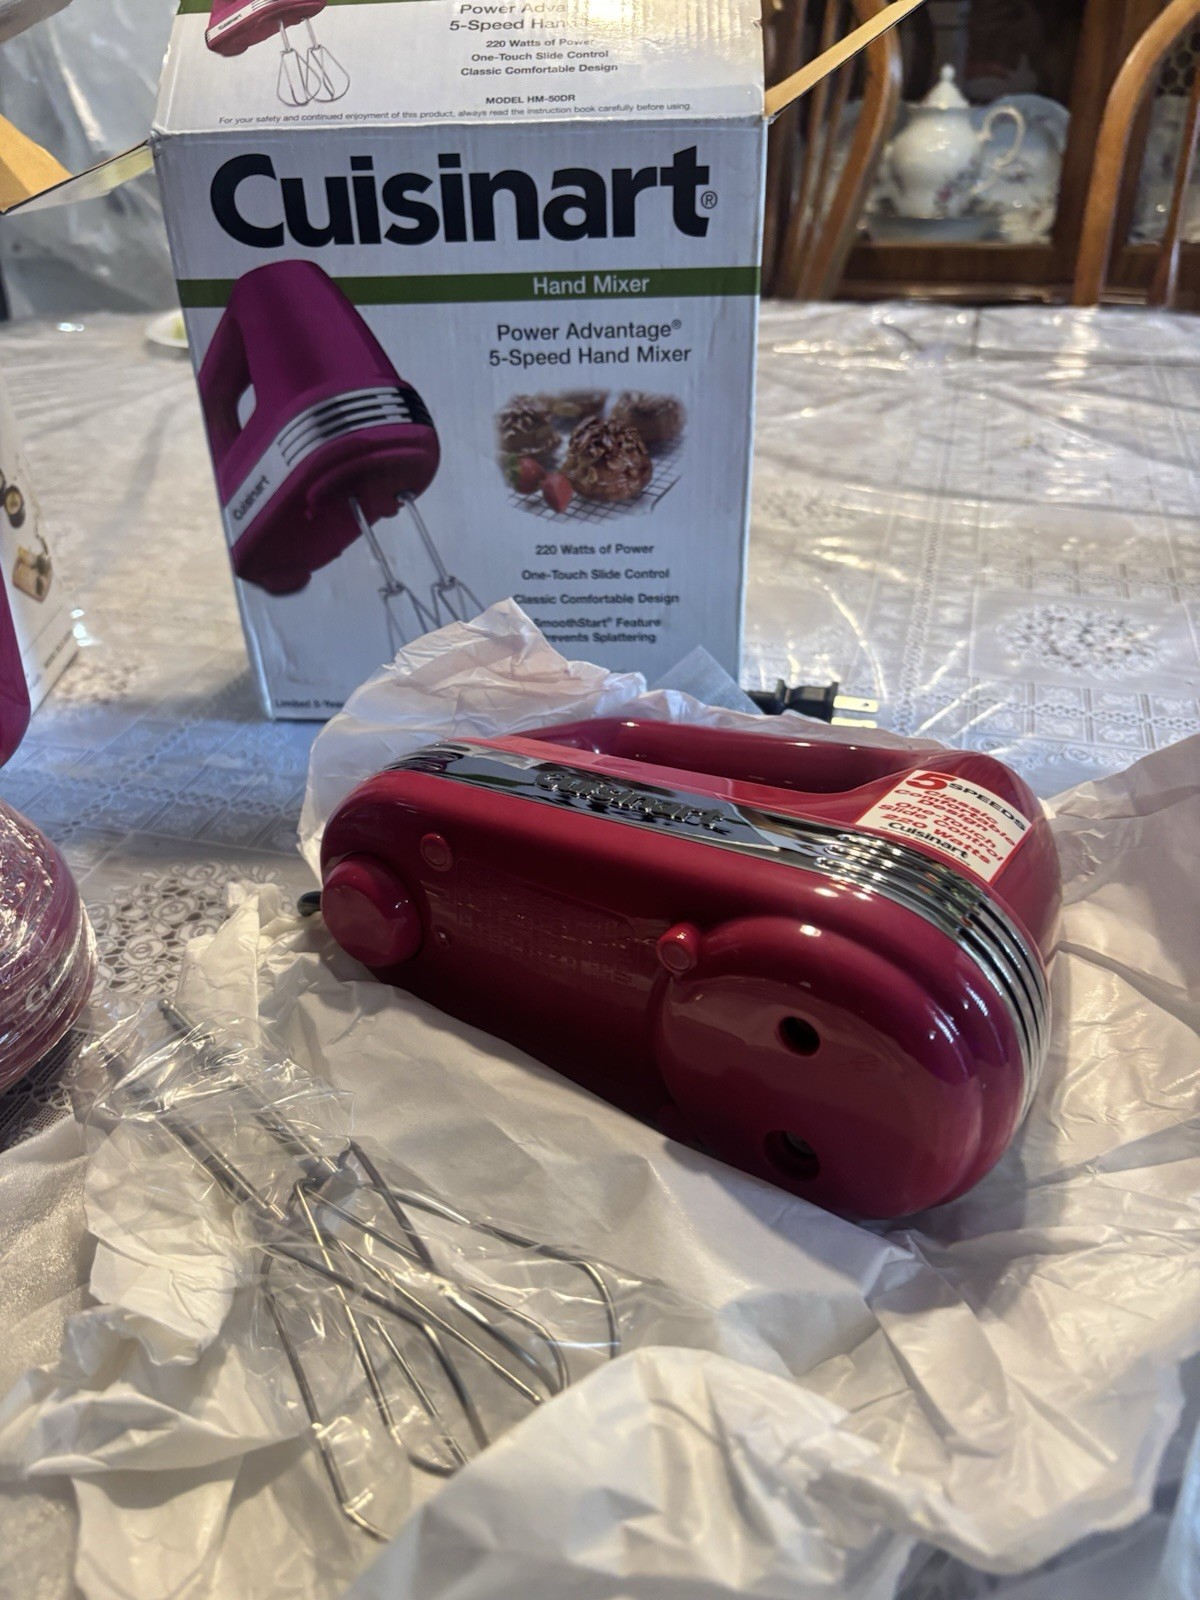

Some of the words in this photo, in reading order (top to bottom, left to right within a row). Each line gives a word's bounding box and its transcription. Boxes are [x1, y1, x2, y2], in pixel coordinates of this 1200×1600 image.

[460, 4, 516, 14] Power
[450, 19, 524, 32] 5-Speed
[485, 40, 506, 48] 220
[509, 39, 541, 48] Watts
[544, 38, 556, 47] of
[559, 38, 595, 46] Power
[471, 52, 533, 62] One-Touch
[536, 52, 564, 61] Slide
[567, 50, 609, 59] Control
[460, 67, 502, 76] Classic
[505, 65, 576, 75] Comfortable
[578, 63, 619, 74] Design
[485, 96, 525, 105] MODEL
[527, 94, 576, 103] HM-50DR
[218, 116, 234, 124] For
[235, 116, 253, 125] your
[256, 115, 281, 124] safety
[283, 114, 300, 122] and
[301, 112, 343, 121] continued
[345, 111, 389, 121] enjoyment
[391, 110, 401, 119] of
[402, 110, 418, 119] this
[458, 108, 488, 118] always
[489, 107, 509, 116] read
[511, 107, 526, 115] the
[527, 105, 572, 115] instruction
[574, 104, 596, 113] book
[598, 103, 634, 113] carefully
[636, 102, 665, 111] before
[533, 275, 587, 296] Hand
[593, 274, 650, 294] Mixer
[496, 323, 560, 342] Power
[489, 348, 571, 370] 5-Speed
[578, 346, 630, 365] Hand
[637, 345, 692, 364] Mixer
[535, 544, 558, 556] 220
[560, 543, 596, 555] Watts
[599, 543, 612, 555] of
[615, 543, 655, 555] Power
[521, 569, 588, 581] One-Touch
[590, 568, 621, 580] Slide
[624, 567, 671, 580] Control
[512, 594, 557, 605] Classic
[560, 593, 634, 605] Comfortable
[637, 592, 680, 606] Design
[615, 616, 662, 628] Feature
[543, 632, 589, 643] revents
[592, 630, 657, 645] Splattering
[905, 772, 957, 791] 5
[948, 782, 1027, 832] SPEEDS
[924, 789, 999, 825] Classic
[880, 813, 928, 829] 220
[894, 788, 1016, 847] Comfortable
[917, 799, 988, 832] Design
[878, 804, 928, 820] Slide
[933, 819, 1004, 861] Control
[895, 801, 997, 849] One-Touch
[888, 821, 969, 859] Cuisinart
